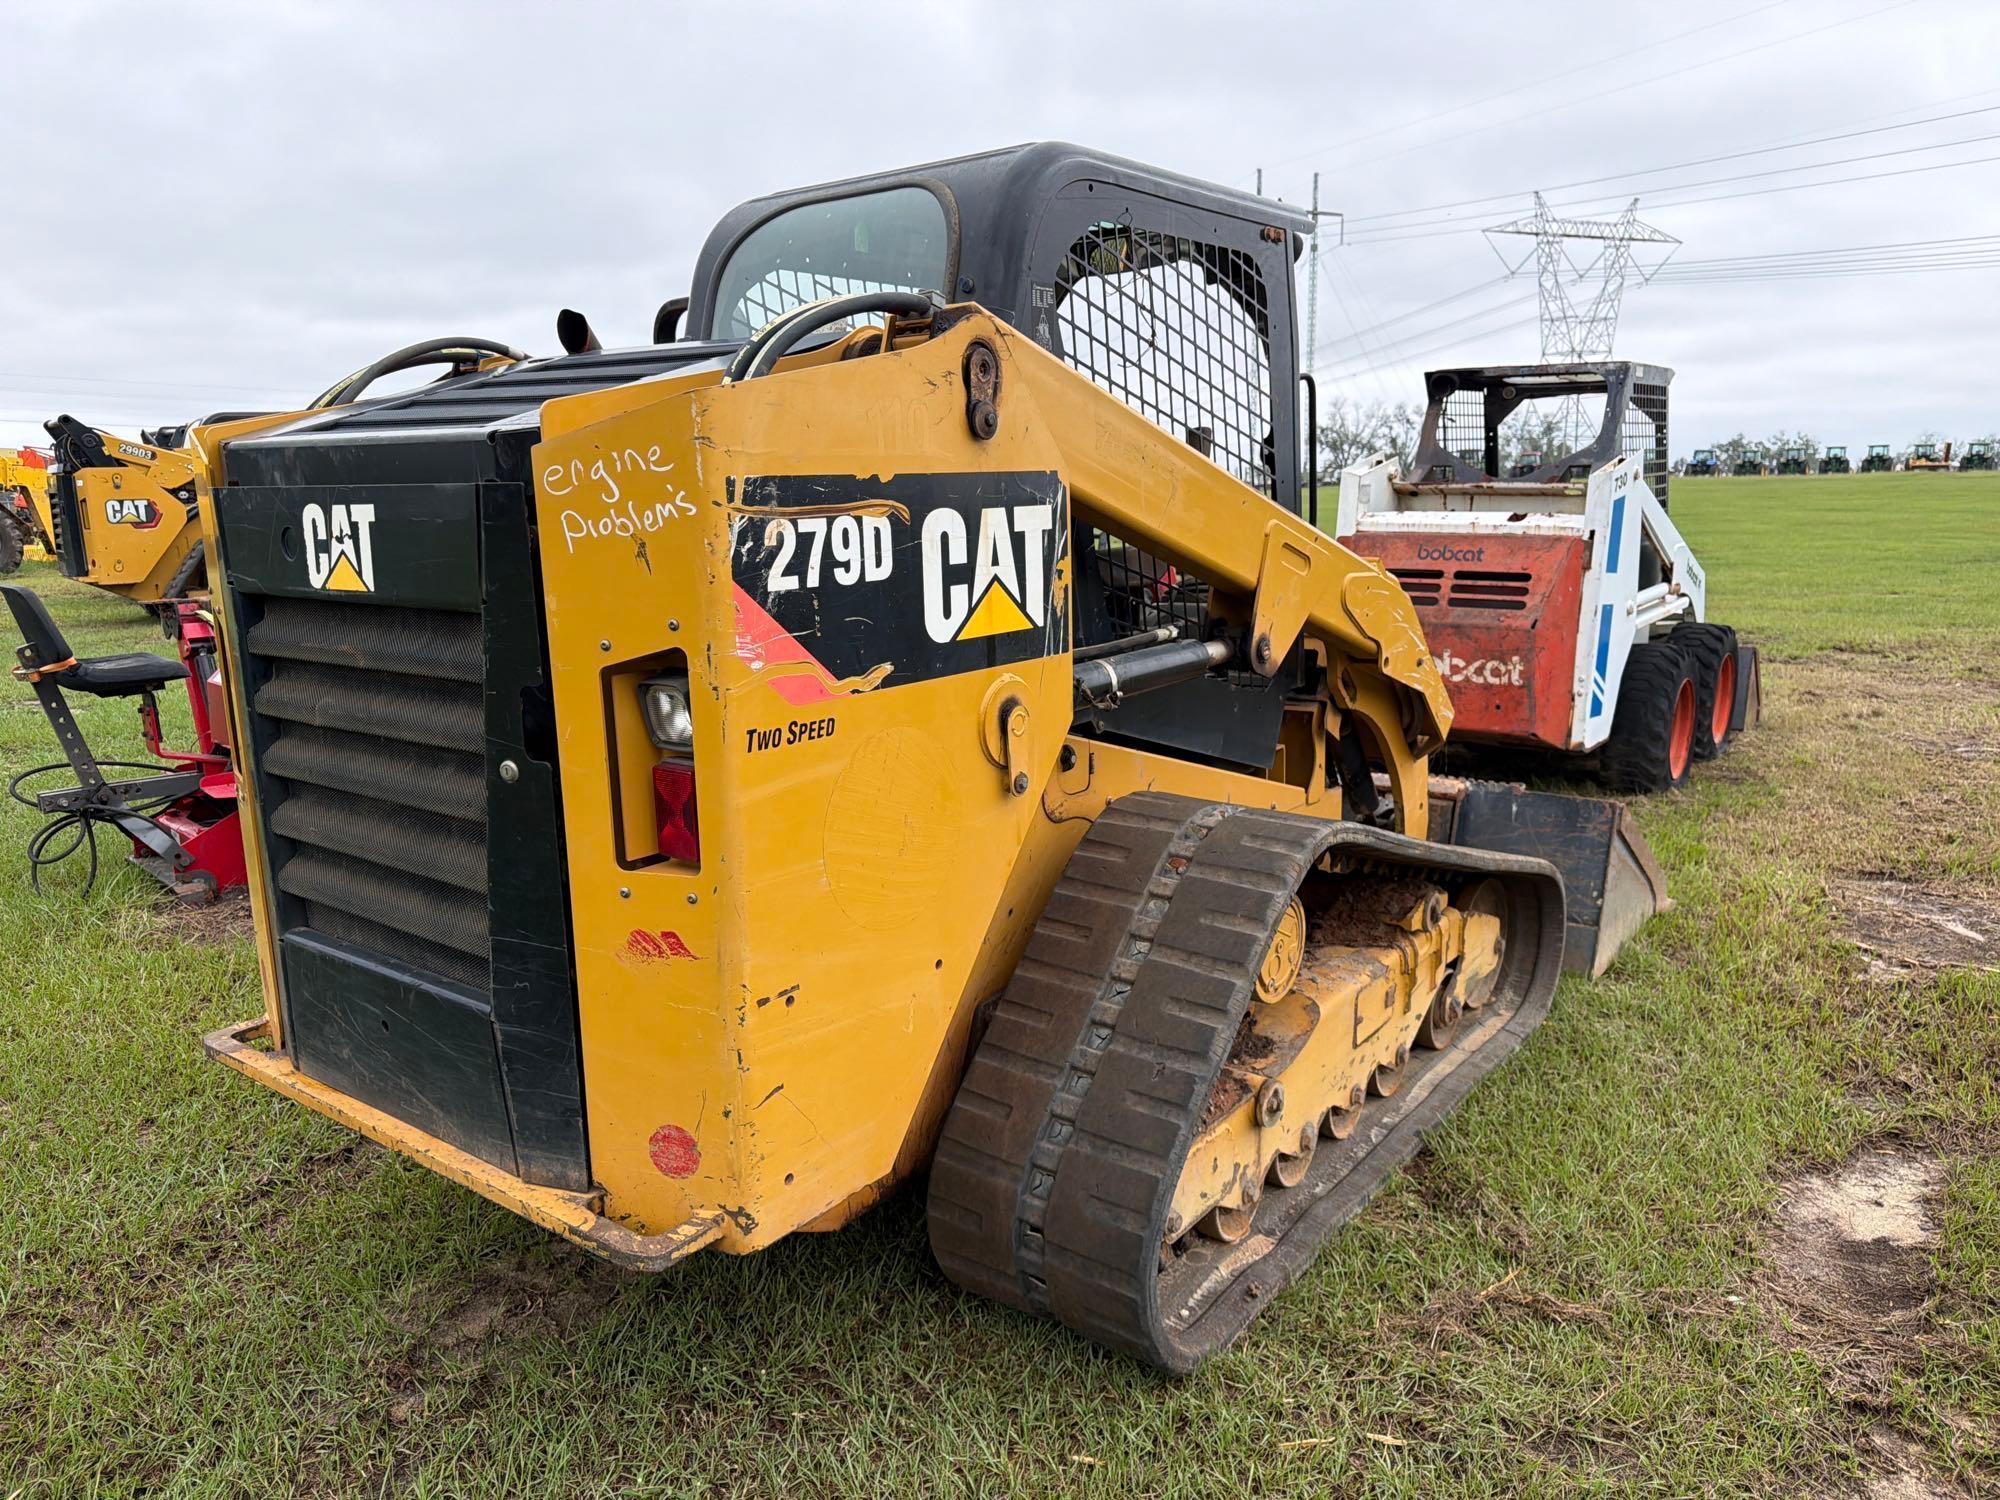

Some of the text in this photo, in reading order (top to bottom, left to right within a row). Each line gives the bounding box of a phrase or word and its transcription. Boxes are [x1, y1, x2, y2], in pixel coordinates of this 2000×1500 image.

[544, 446, 675, 503] engine
[1614, 472, 1628, 492] 730
[106, 500, 148, 524] CAT
[302, 503, 376, 592] CAT
[764, 515, 893, 592] 279D
[921, 504, 1053, 644] CAT
[1417, 543, 1485, 562] bobcat
